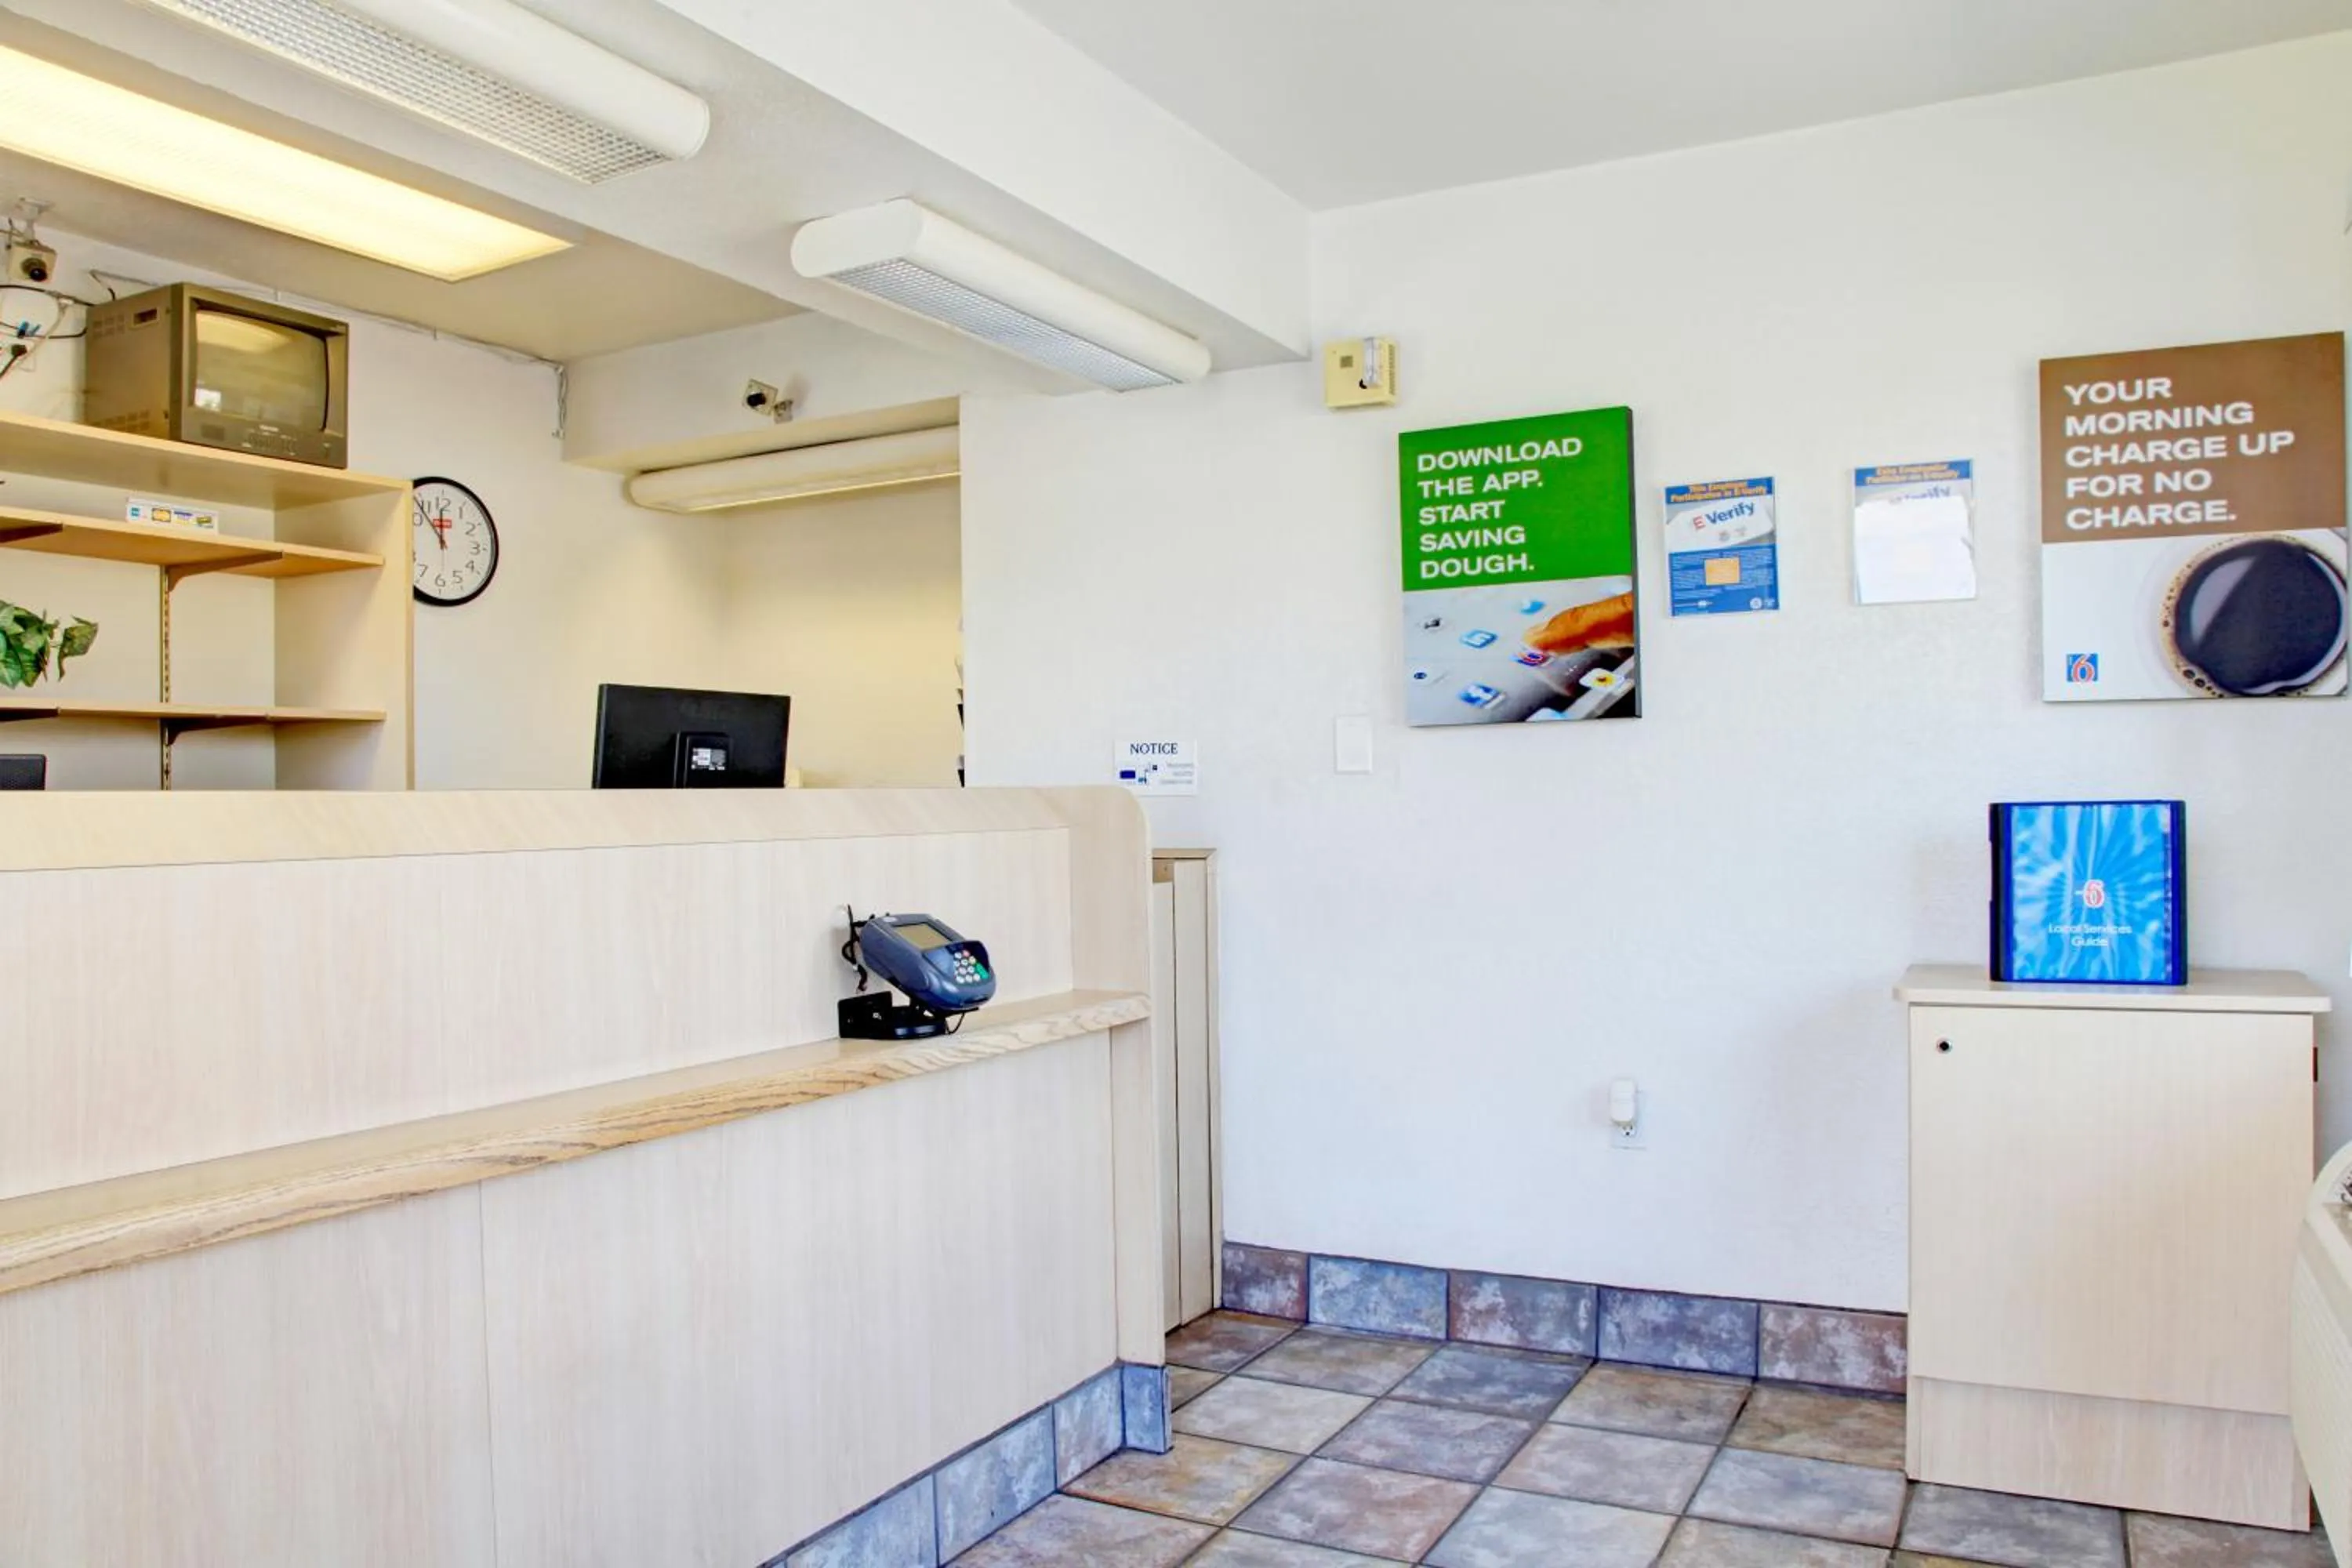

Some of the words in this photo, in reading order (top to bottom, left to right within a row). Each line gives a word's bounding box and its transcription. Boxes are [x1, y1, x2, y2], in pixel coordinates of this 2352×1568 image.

[2063, 377, 2172, 405] YOUR
[2065, 402, 2254, 437] MORNING
[1417, 437, 1583, 472] DOWNLOAD
[2065, 436, 2227, 467] CHARGE
[2238, 430, 2295, 456] UP
[1417, 476, 1474, 499] THE
[1482, 470, 1544, 492] APP.
[2066, 474, 2143, 499] FOR
[2154, 469, 2212, 494] NO
[435, 496, 451, 512] 12
[1419, 500, 1505, 525] START
[1705, 501, 1755, 524] Verify
[2066, 499, 2237, 531] CHARGE.
[464, 521, 476, 536] 2
[1420, 525, 1526, 552] SAVING
[470, 541, 481, 556] 3
[418, 564, 429, 578] 7
[452, 570, 463, 584] 5
[465, 560, 474, 572] 4
[1420, 553, 1535, 579] DOUGH.
[434, 573, 446, 587] 6
[1130, 742, 1178, 755] NOTICE
